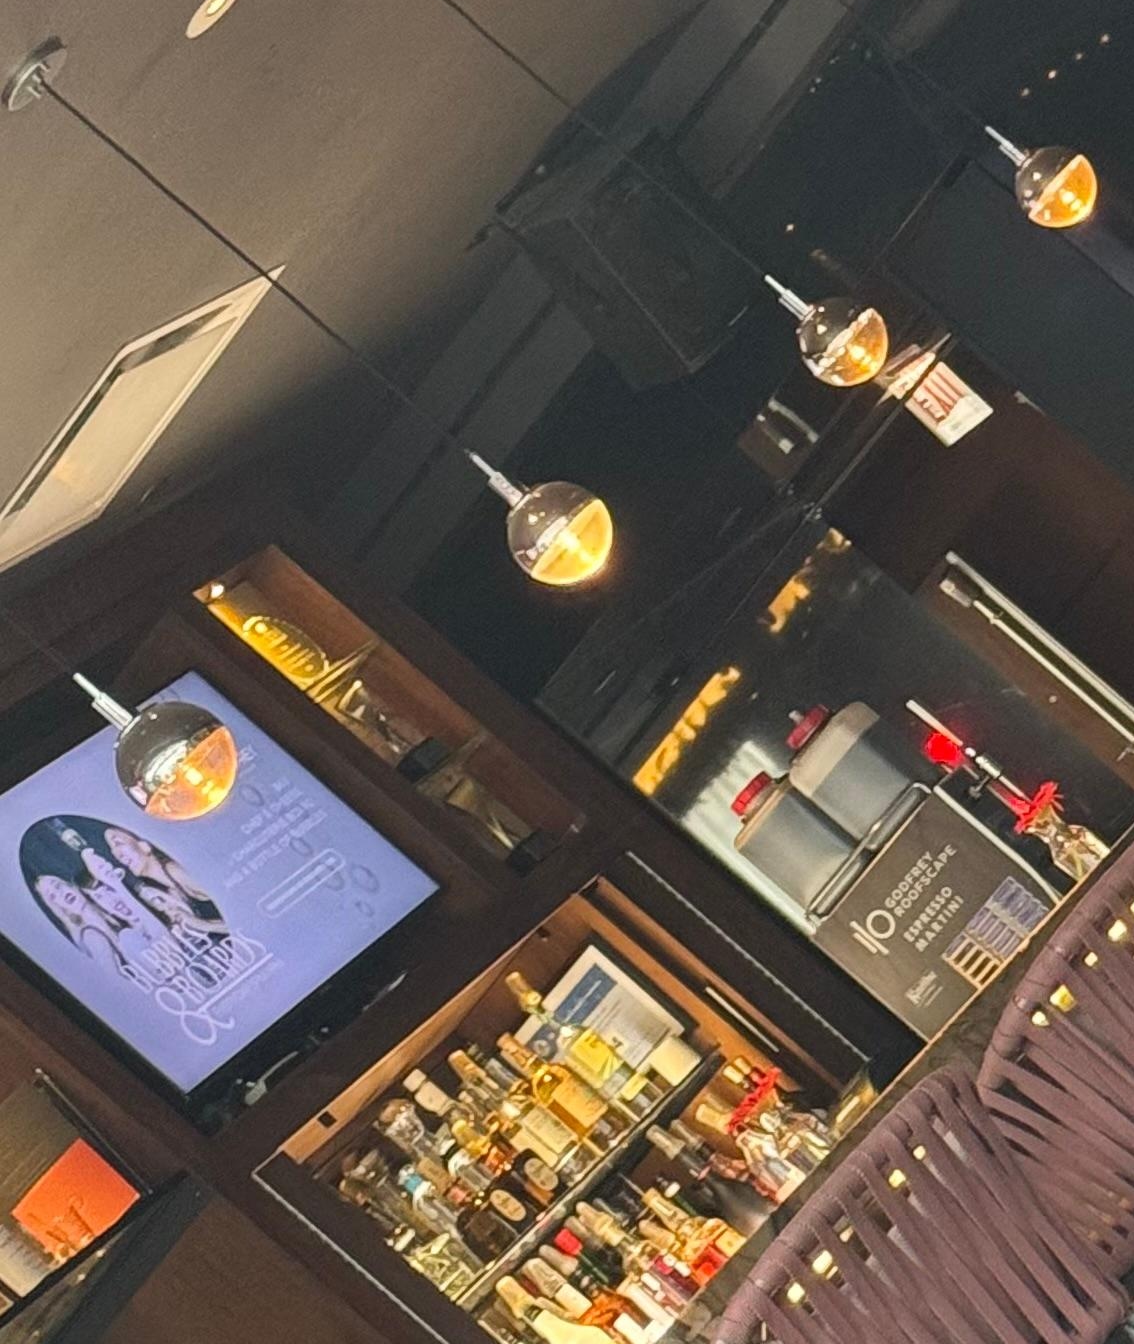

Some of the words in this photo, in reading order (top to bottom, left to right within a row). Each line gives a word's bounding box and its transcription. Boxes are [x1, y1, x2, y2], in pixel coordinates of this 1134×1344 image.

[884, 850, 933, 909] GODFREY
[894, 843, 957, 919] ROOFSCAPE
[903, 885, 952, 943] ESPRESSO
[914, 895, 964, 953] MARTINI
